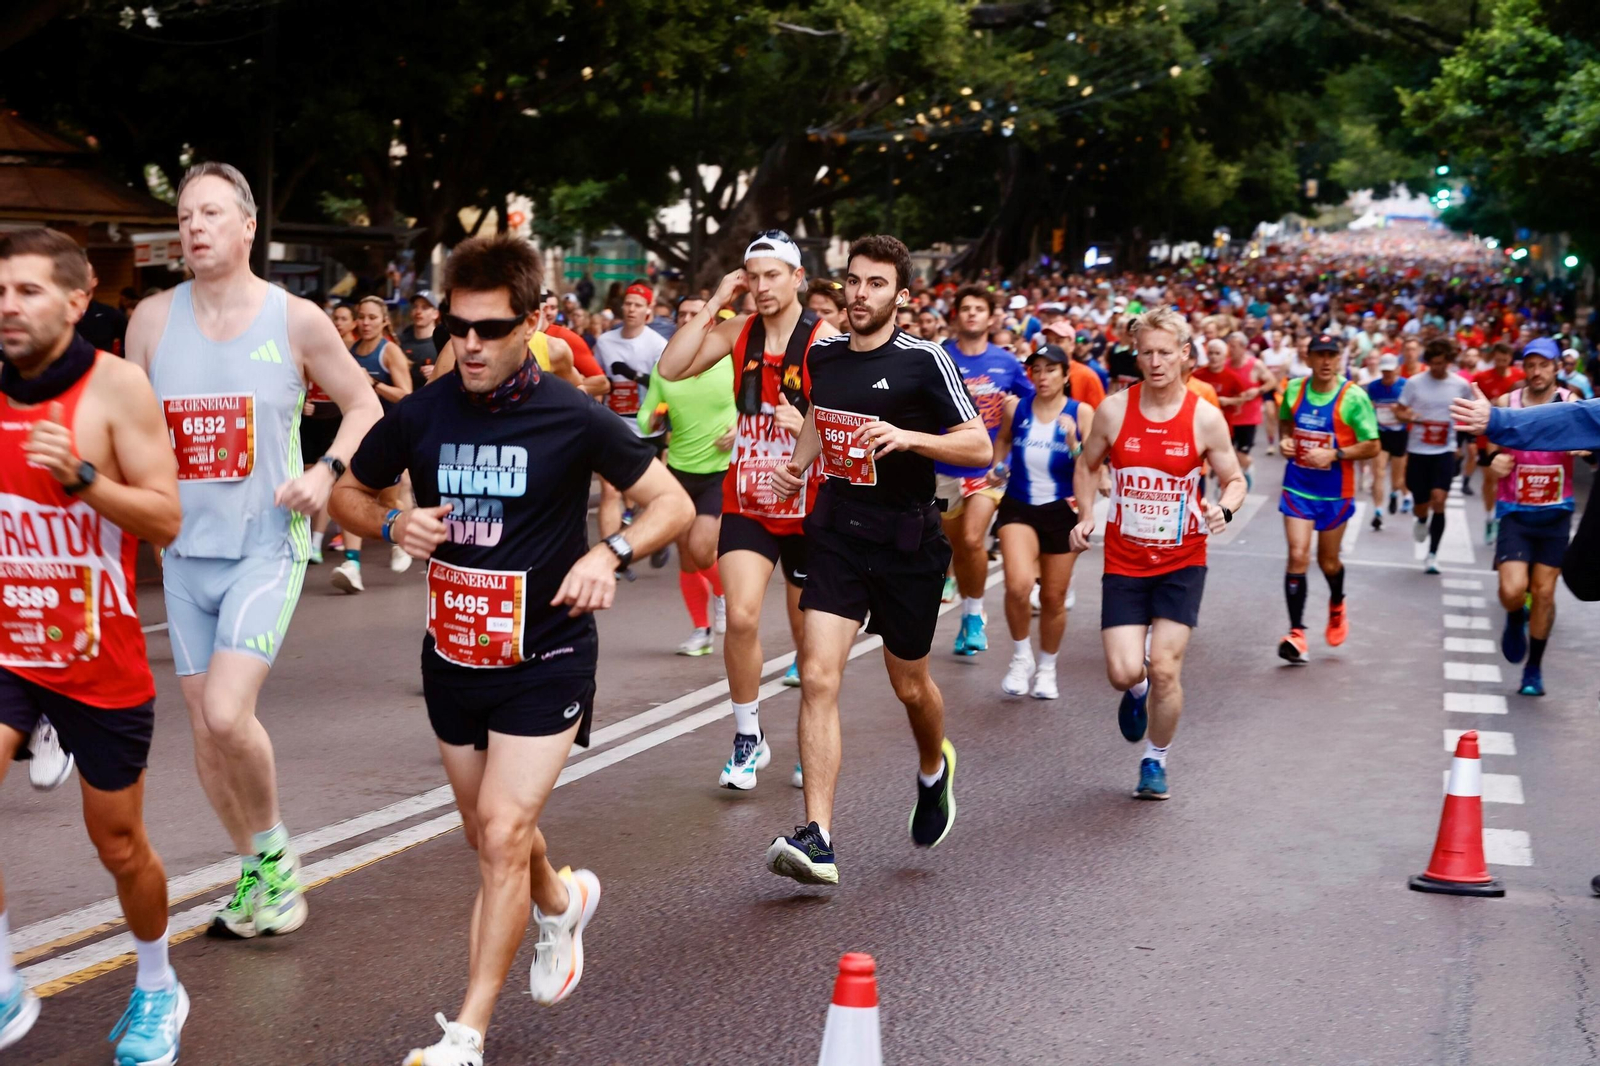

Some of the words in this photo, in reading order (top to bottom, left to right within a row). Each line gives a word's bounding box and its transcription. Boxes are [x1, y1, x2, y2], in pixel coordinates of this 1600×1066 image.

[184, 397, 240, 411] GENERALI
[182, 416, 226, 435] 6532
[192, 435, 216, 443] PHILIPP
[825, 428, 852, 445] 5691
[438, 444, 528, 497] MAD
[1133, 503, 1170, 516] 18316
[446, 569, 507, 590] GENERALI
[443, 590, 490, 616] 6495
[455, 613, 475, 624] PABLO
